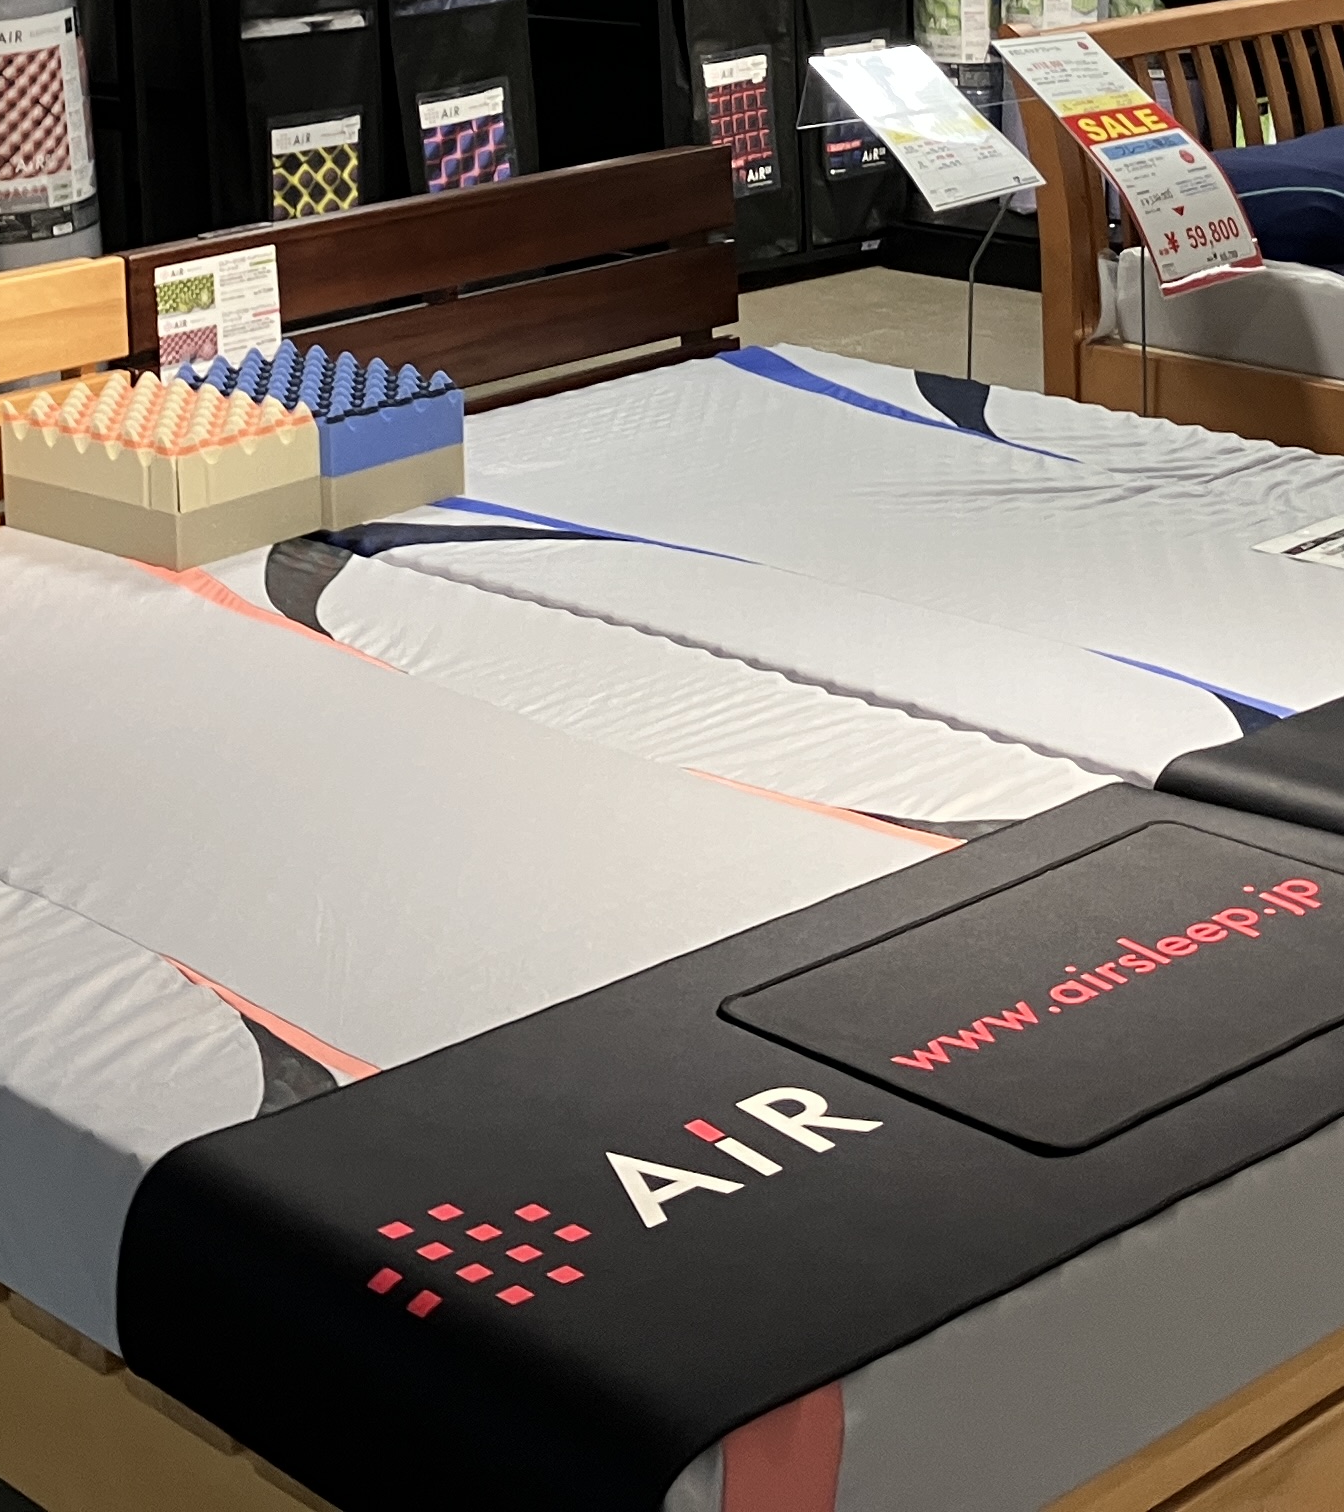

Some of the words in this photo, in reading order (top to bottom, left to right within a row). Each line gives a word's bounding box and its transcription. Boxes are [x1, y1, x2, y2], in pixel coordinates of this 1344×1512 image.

[1077, 108, 1168, 143] SALE
[1186, 216, 1240, 250] 59,800
[892, 873, 1322, 1073] www.airsleep.jp
